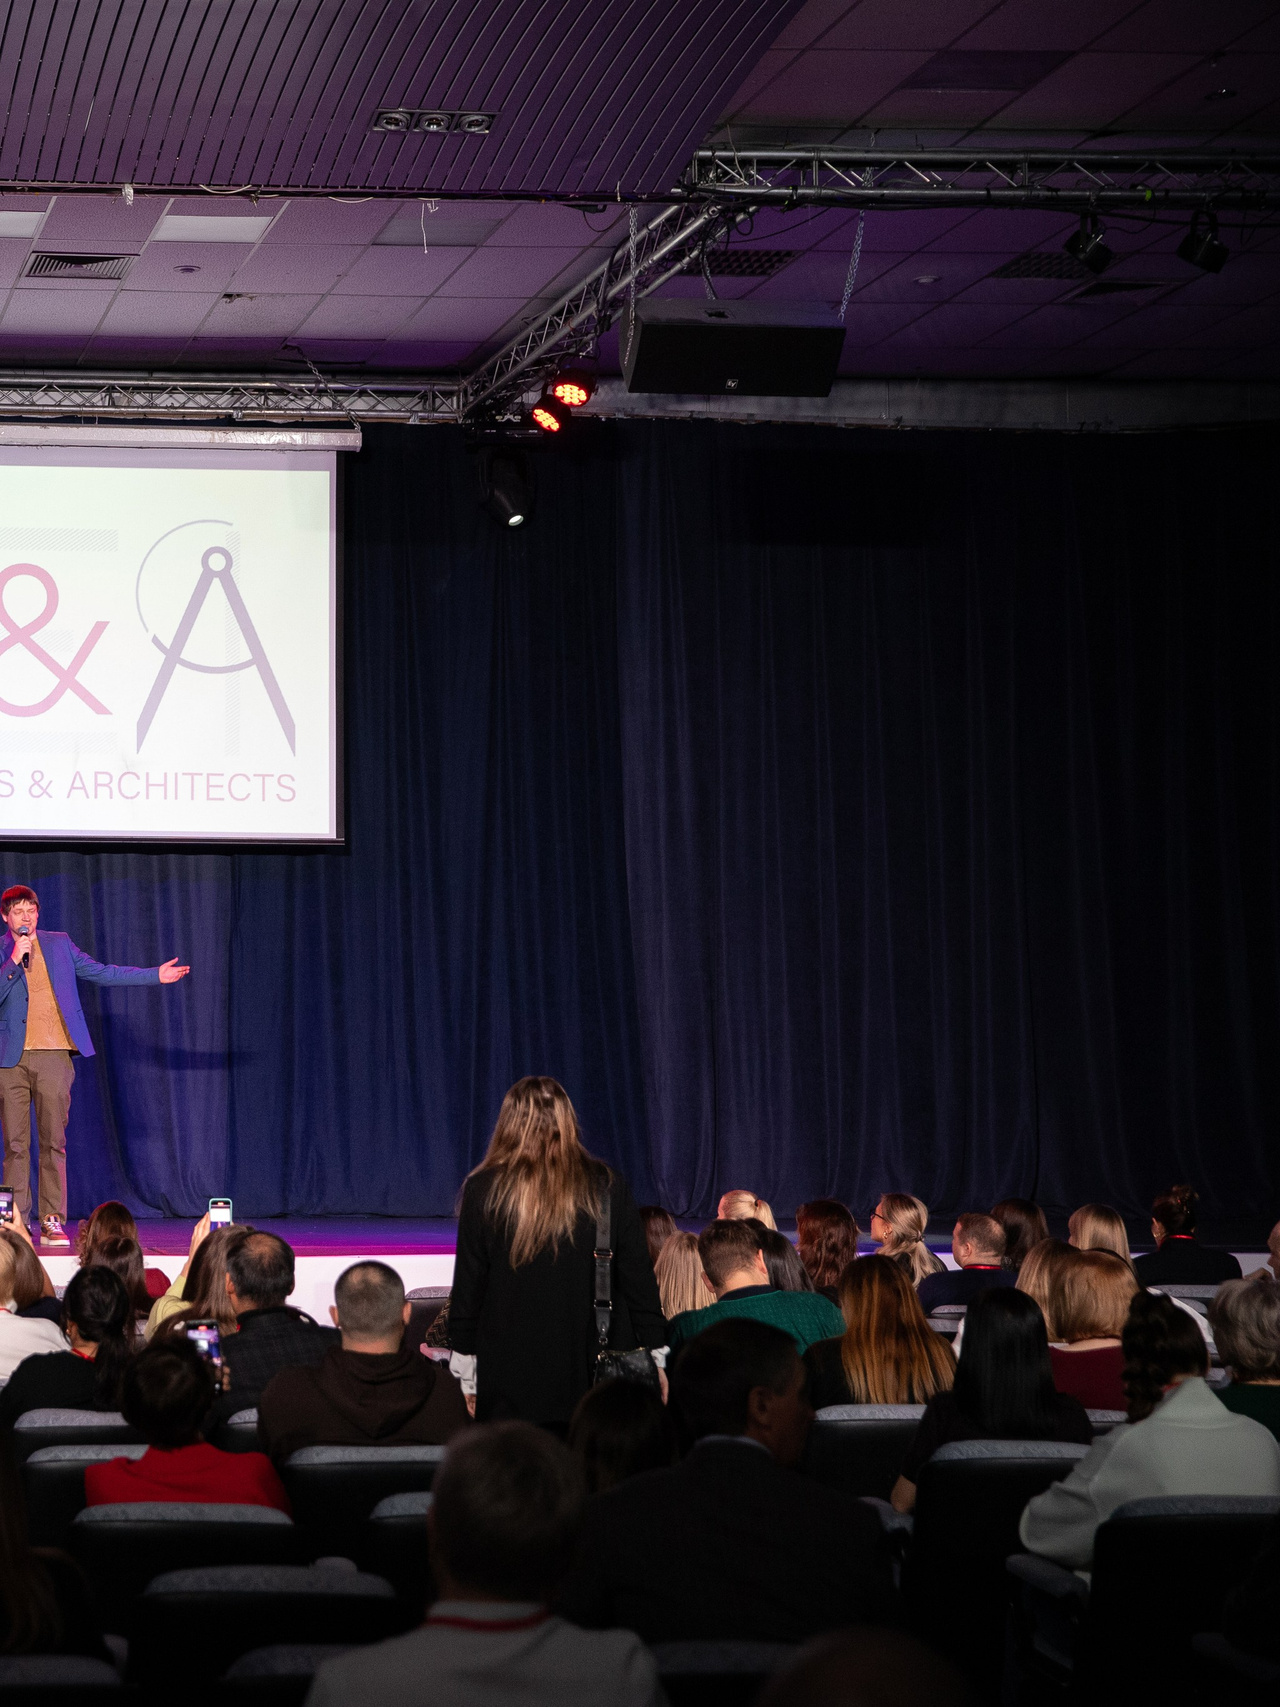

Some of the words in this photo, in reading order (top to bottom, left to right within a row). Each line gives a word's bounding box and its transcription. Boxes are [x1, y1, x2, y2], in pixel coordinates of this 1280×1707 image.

[135, 519, 296, 757] A
[28, 769, 53, 799] &
[66, 770, 297, 803] ARCHITECTS
